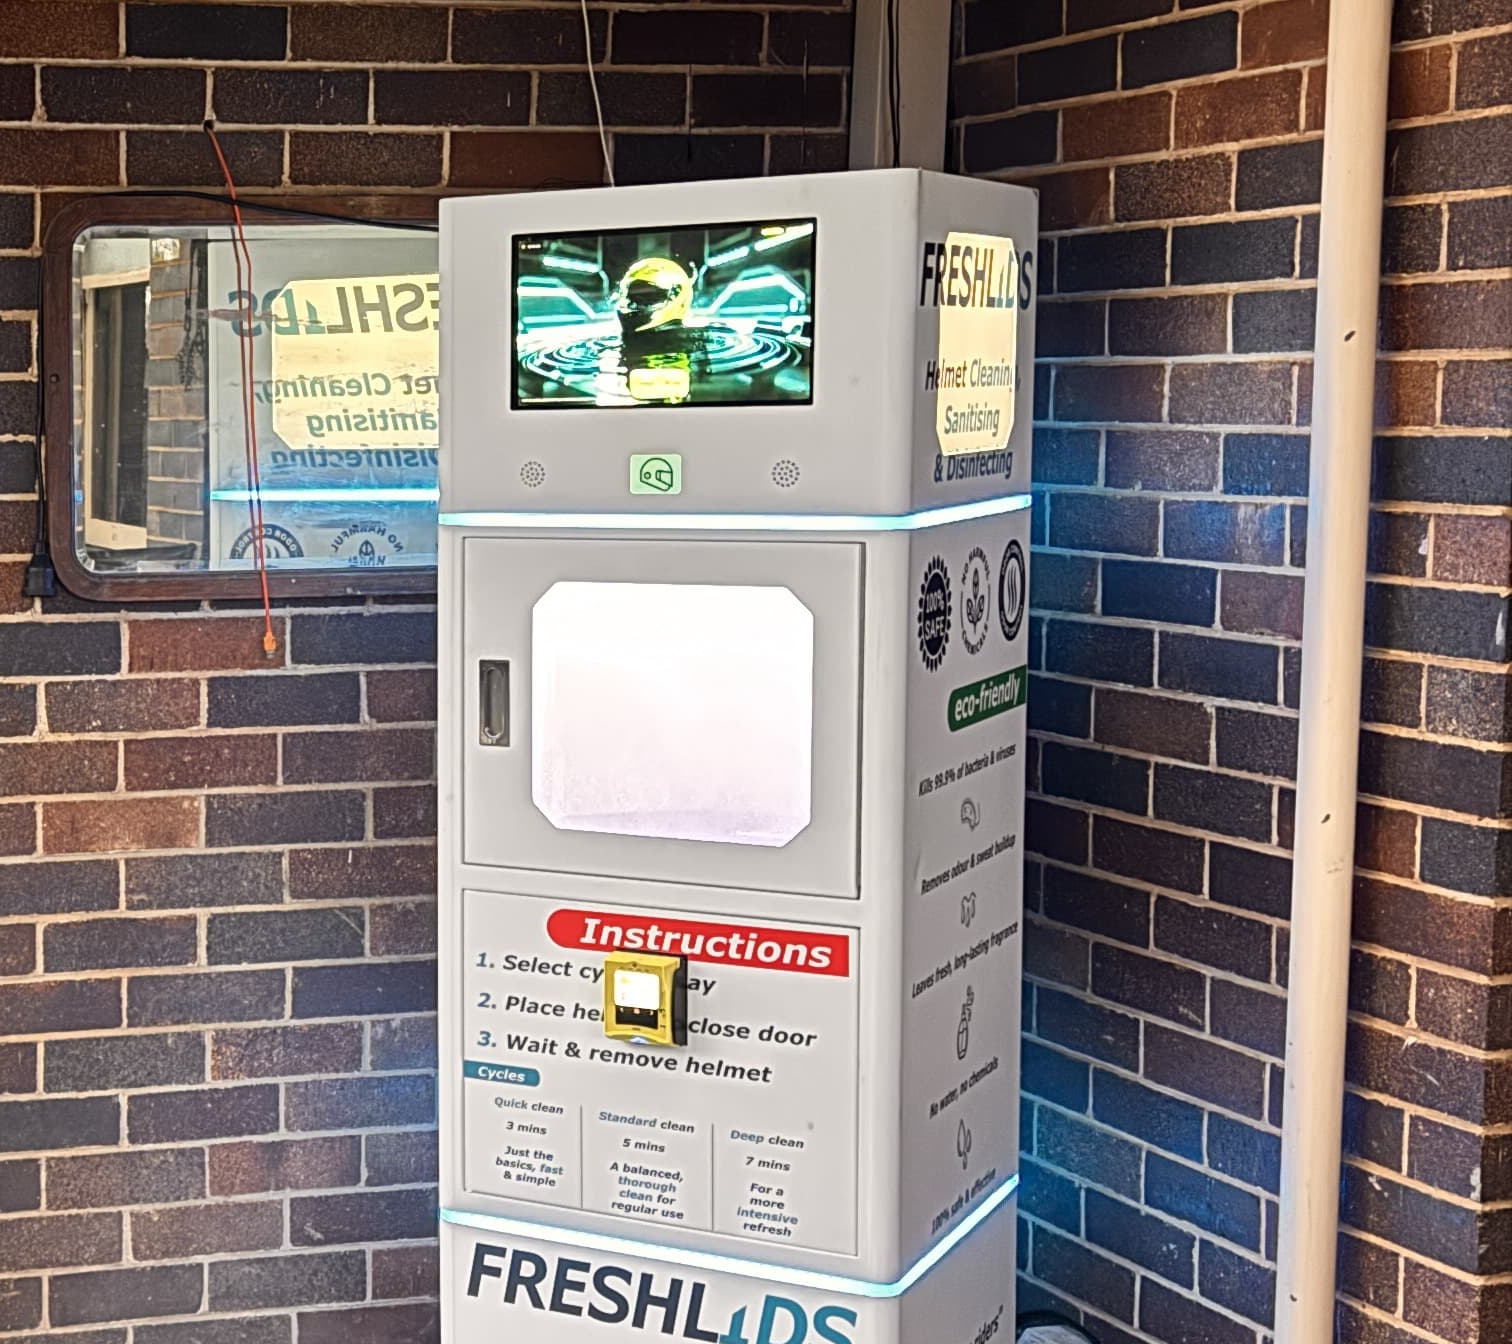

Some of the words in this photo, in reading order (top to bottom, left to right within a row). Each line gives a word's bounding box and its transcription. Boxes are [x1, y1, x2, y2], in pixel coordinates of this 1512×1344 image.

[920, 242, 1033, 311] FRESHLIDS
[925, 358, 967, 391] Helmet
[944, 402, 1000, 437] Sanitising
[934, 453, 943, 483] &
[946, 446, 1013, 480] Disinfecting
[926, 589, 944, 613] 100%
[925, 616, 944, 640] SAFE
[954, 672, 1021, 722] eco-friendly
[579, 918, 832, 968] Instructions
[476, 952, 495, 969] 1.
[503, 955, 572, 977] Select
[688, 977, 717, 996] ay
[912, 974, 934, 999] Leaves
[477, 992, 497, 1010] 2.
[505, 996, 566, 1017] Place
[688, 1017, 750, 1039] close
[758, 1025, 818, 1047] door
[477, 1031, 497, 1048] 3.
[506, 1034, 558, 1056] Wait
[564, 1042, 582, 1059] &
[589, 1048, 678, 1071] remove
[685, 1056, 772, 1083] helmet
[477, 1066, 526, 1084] Cycles
[494, 1096, 528, 1110] Quick
[531, 1102, 564, 1114] clean
[505, 1121, 514, 1130] 3
[517, 1123, 547, 1135] mins
[599, 1111, 658, 1127] Standard
[660, 1120, 695, 1134] clean
[622, 1138, 631, 1148] 5
[634, 1141, 666, 1153] mins
[730, 1129, 765, 1144] Deep
[768, 1135, 805, 1149] clean
[504, 1145, 530, 1158] Just
[533, 1149, 554, 1161] the
[495, 1156, 536, 1172] basics,
[540, 1163, 564, 1175] fast
[609, 1161, 619, 1172] A
[623, 1163, 684, 1183] balanced,
[745, 1156, 755, 1166] 7
[757, 1159, 791, 1171] mins
[503, 1170, 512, 1180] &
[515, 1173, 556, 1187] simple
[618, 1175, 677, 1193] thorough
[619, 1189, 653, 1202] clean
[656, 1194, 677, 1205] for
[750, 1182, 773, 1195] For
[775, 1187, 784, 1196] a
[611, 1201, 658, 1215] regular
[661, 1209, 684, 1220] use
[749, 1197, 785, 1210] more
[736, 1206, 798, 1225] intensive
[743, 1222, 792, 1237] refresh
